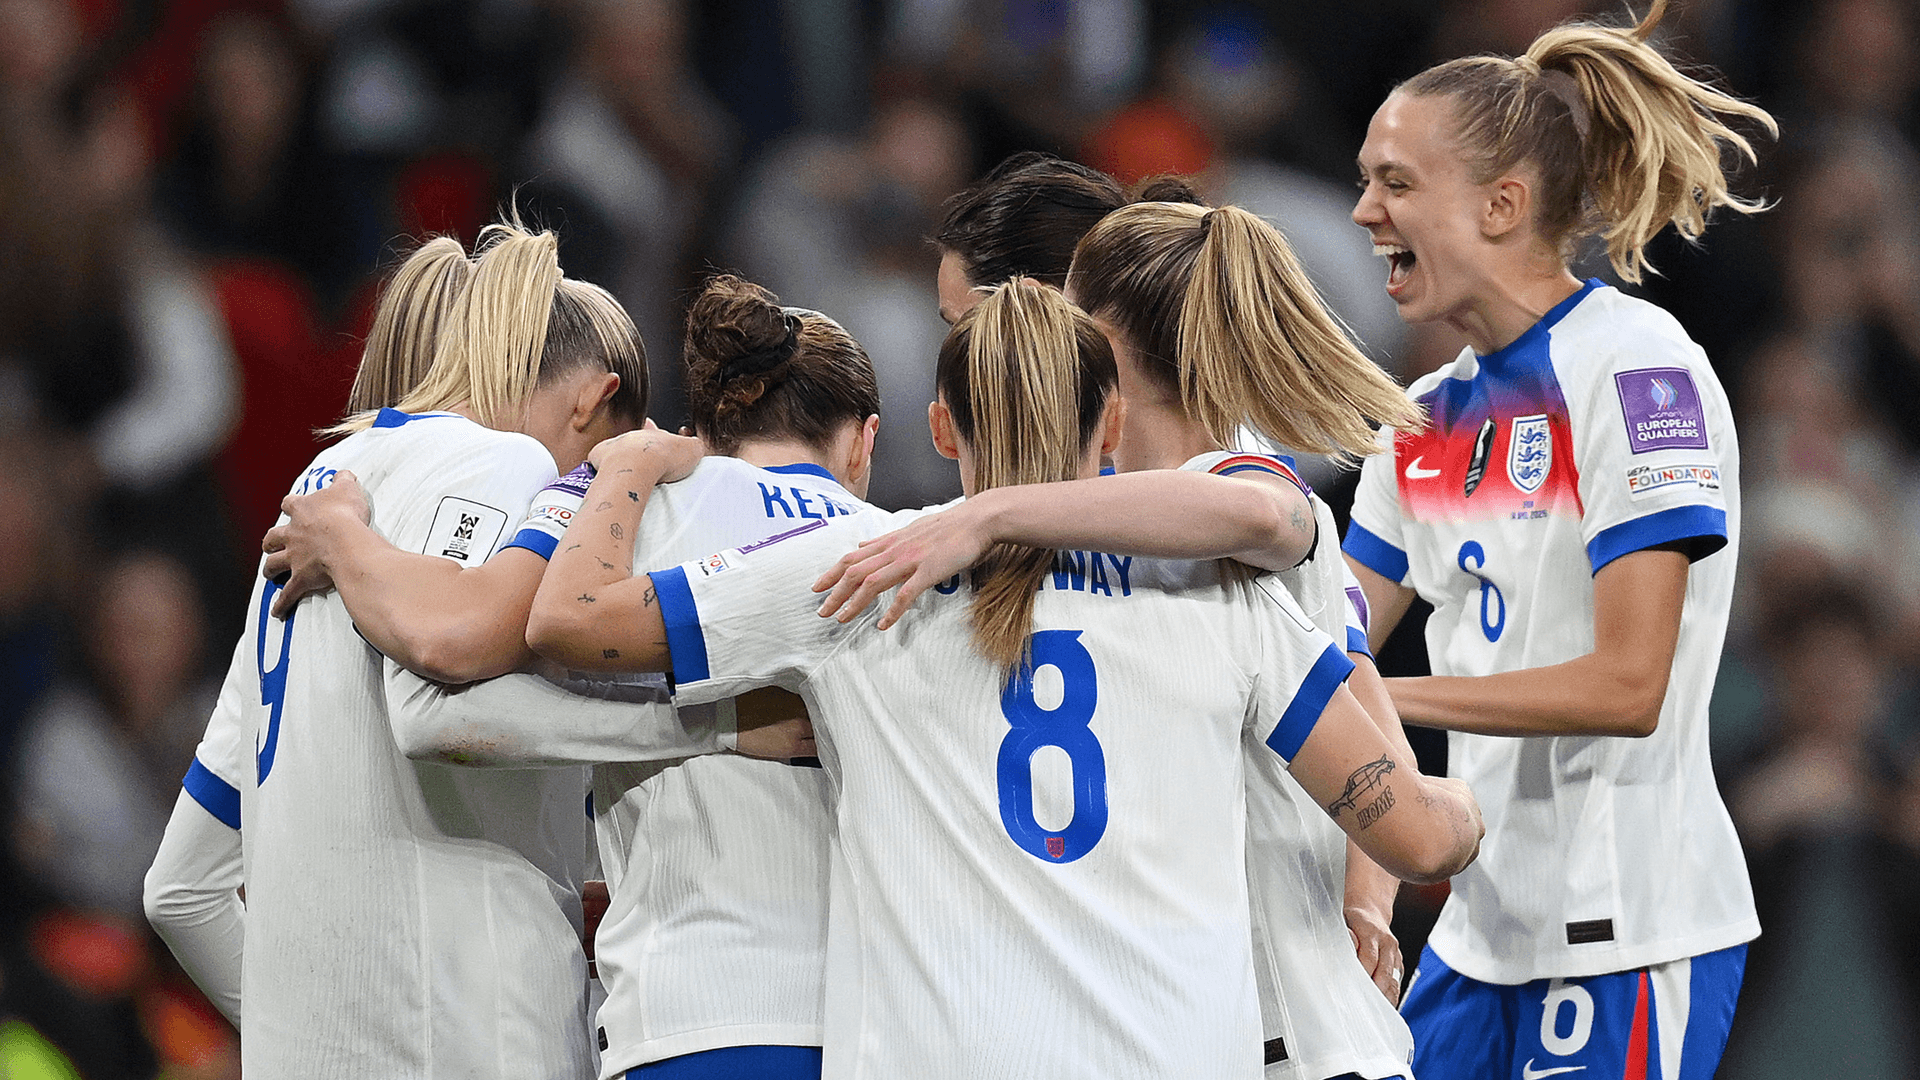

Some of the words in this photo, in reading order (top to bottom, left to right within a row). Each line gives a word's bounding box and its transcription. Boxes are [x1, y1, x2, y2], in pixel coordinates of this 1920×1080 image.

[1637, 419, 1697, 432] EUROPEAN
[1637, 428, 1699, 441] QUALIFIERS
[1627, 466, 1650, 477] UEFA
[1628, 467, 1719, 490] FOUNDATION
[257, 578, 296, 788] 9
[996, 629, 1109, 864] 8
[1356, 785, 1396, 830] HOME
[1540, 978, 1594, 1057] 6
